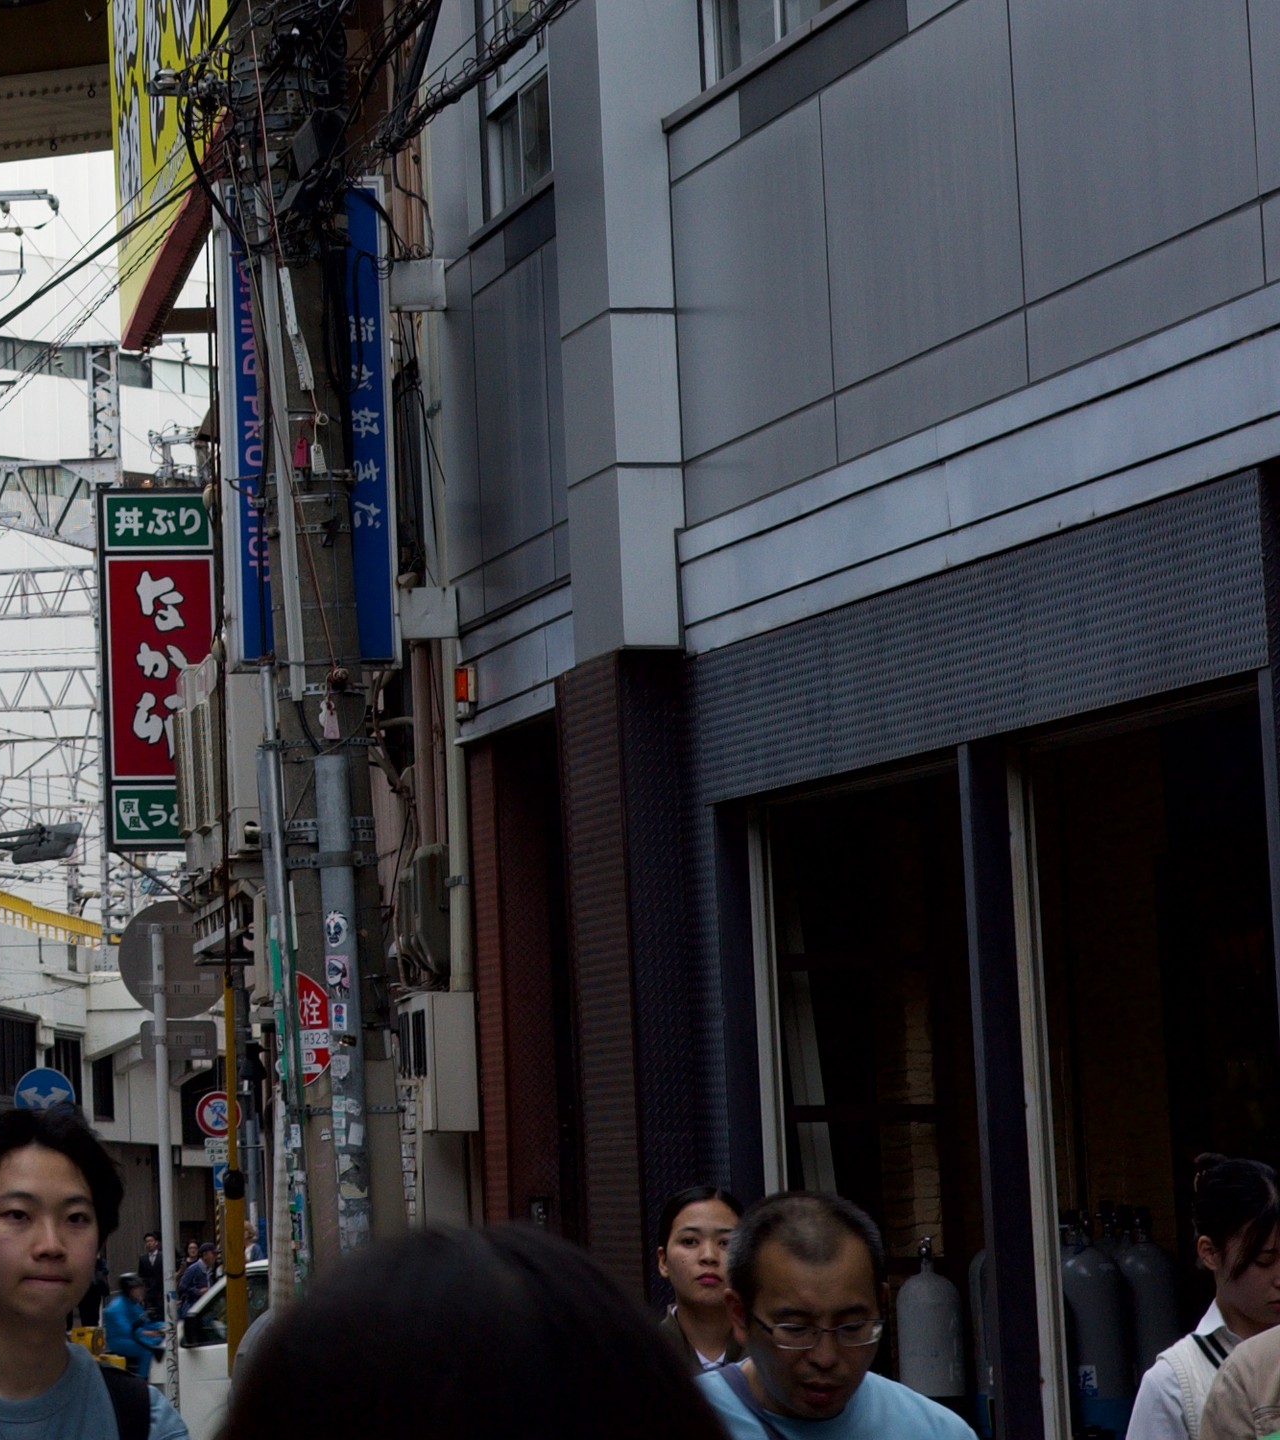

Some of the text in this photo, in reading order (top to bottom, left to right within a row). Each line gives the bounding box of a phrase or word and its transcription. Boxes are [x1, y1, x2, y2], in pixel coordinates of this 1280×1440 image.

[114, 506, 202, 537] 丼ぶり
[298, 989, 322, 1027] 栓
